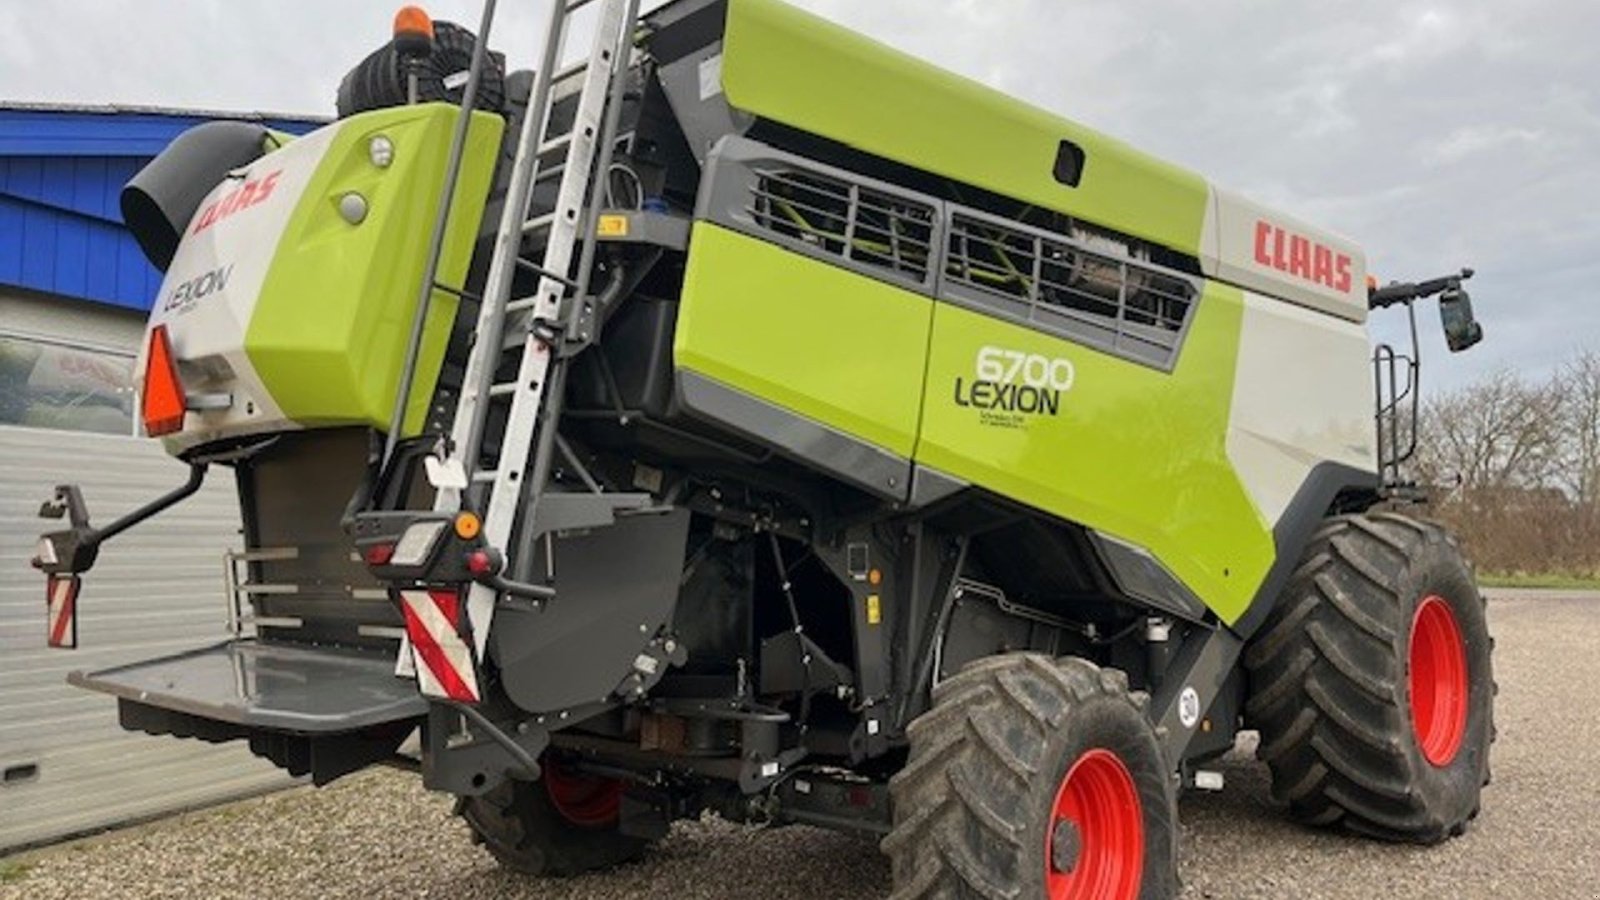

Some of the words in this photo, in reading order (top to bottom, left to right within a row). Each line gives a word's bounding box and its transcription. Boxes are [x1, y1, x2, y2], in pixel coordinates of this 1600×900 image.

[193, 169, 283, 235] CLAAS
[1254, 219, 1351, 293] CLAAS
[164, 263, 234, 312] LEXION
[976, 345, 1075, 391] 6700
[954, 376, 1060, 416] LEXION
